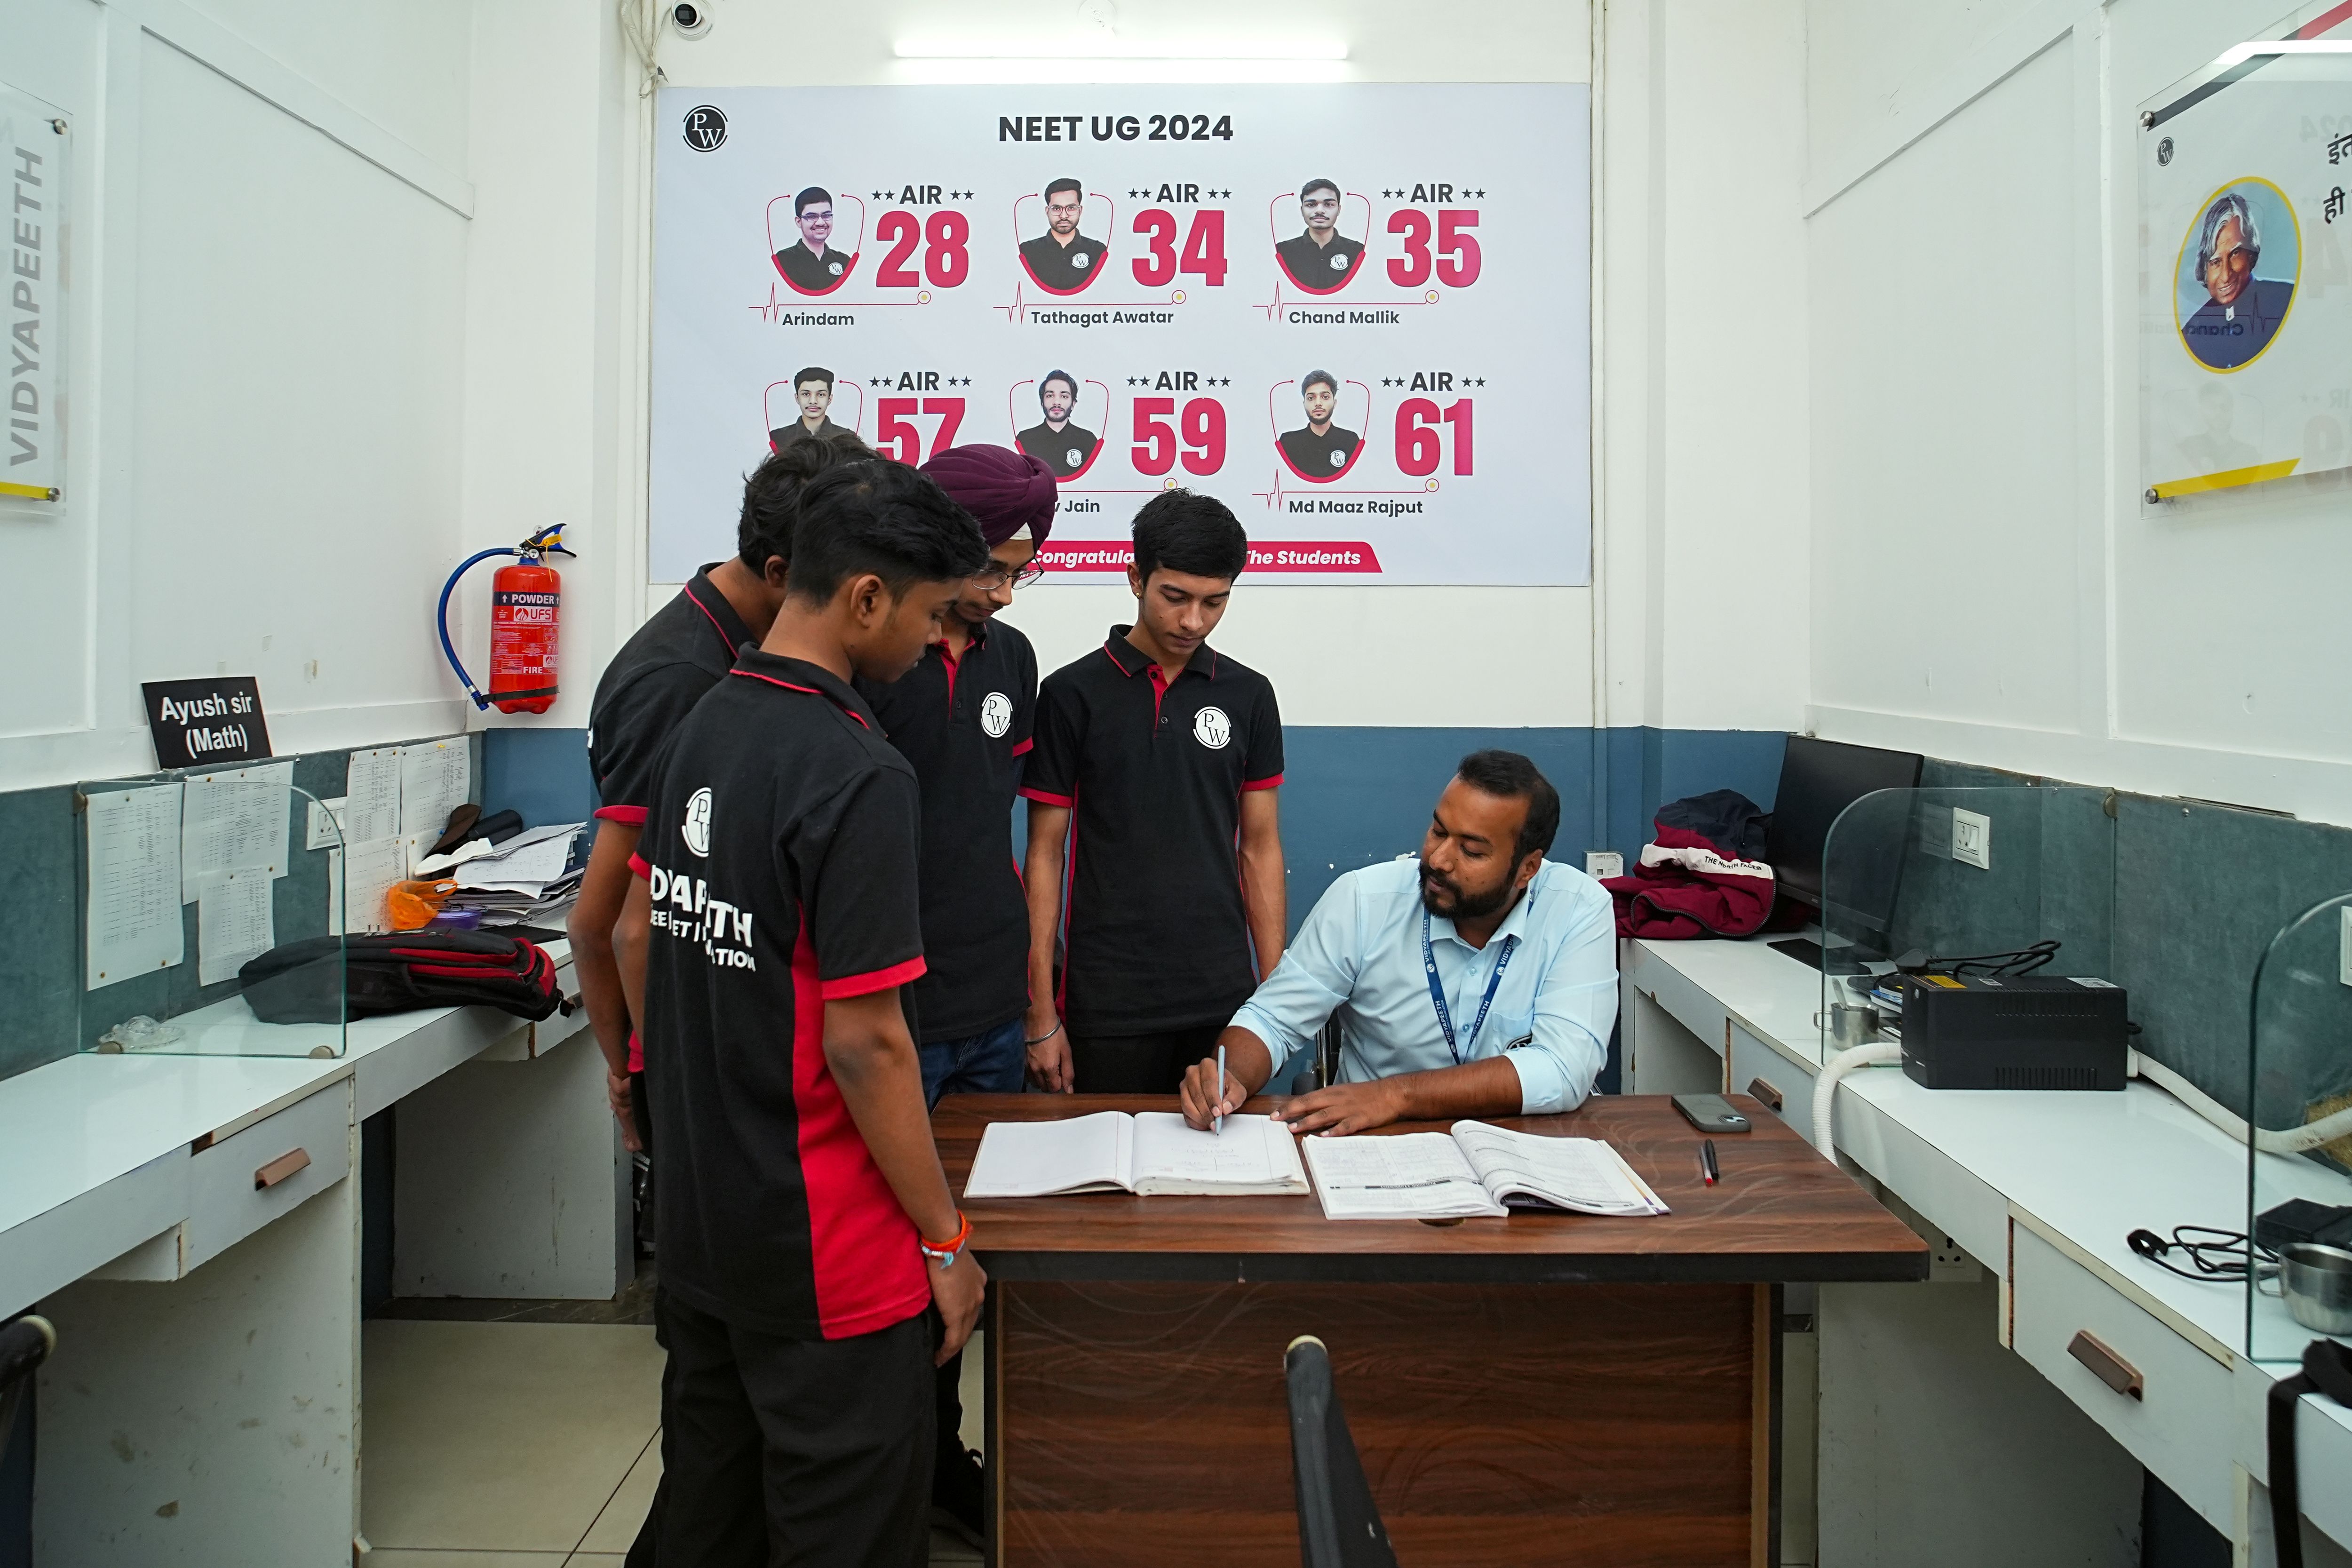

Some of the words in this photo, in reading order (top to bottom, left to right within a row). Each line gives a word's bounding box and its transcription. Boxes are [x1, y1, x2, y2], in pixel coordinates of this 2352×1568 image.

[691, 112, 723, 147] PW
[1000, 117, 1082, 141] NEET
[1092, 116, 1140, 141] UG
[1149, 115, 1233, 140] 2024
[2160, 142, 2172, 163] PW
[2327, 133, 2352, 165] इंत
[899, 185, 941, 204] AIR
[1156, 184, 1199, 202] AIR
[1410, 184, 1453, 202] AIR
[2323, 186, 2345, 224] ही
[876, 211, 969, 288] 28
[1132, 209, 1227, 287] 34
[1387, 209, 1481, 287] 35
[9, 147, 43, 466] VIDYAPEETH
[1289, 311, 1345, 324] Chand
[1350, 310, 1399, 324] Mallik
[782, 312, 854, 326] Arindam
[1032, 311, 1108, 328] Tathagat
[1113, 311, 1174, 323] Awatar
[898, 372, 939, 391] AIR
[1155, 372, 1198, 390] AIR
[1410, 373, 1453, 391] AIR
[876, 398, 965, 469] 57
[1131, 398, 1226, 476] 59
[1395, 398, 1473, 476] 61
[1065, 499, 1100, 512] Jain
[1289, 501, 1314, 513] Md
[1319, 501, 1364, 513] Maaz
[1368, 500, 1423, 517] Rajput
[1030, 550, 1135, 568] Congratula
[1277, 550, 1361, 565] Students
[512, 594, 554, 605] POWDER
[531, 609, 551, 620] UFS
[161, 692, 228, 725] Ayush
[230, 691, 252, 714] sir
[986, 699, 1008, 732] PW
[1202, 712, 1226, 745] PW
[186, 724, 248, 759] (Math)
[1705, 856, 1717, 865] THE
[1718, 860, 1738, 869] NORTH
[1435, 1000, 1452, 1043] VIDYAPEETH
